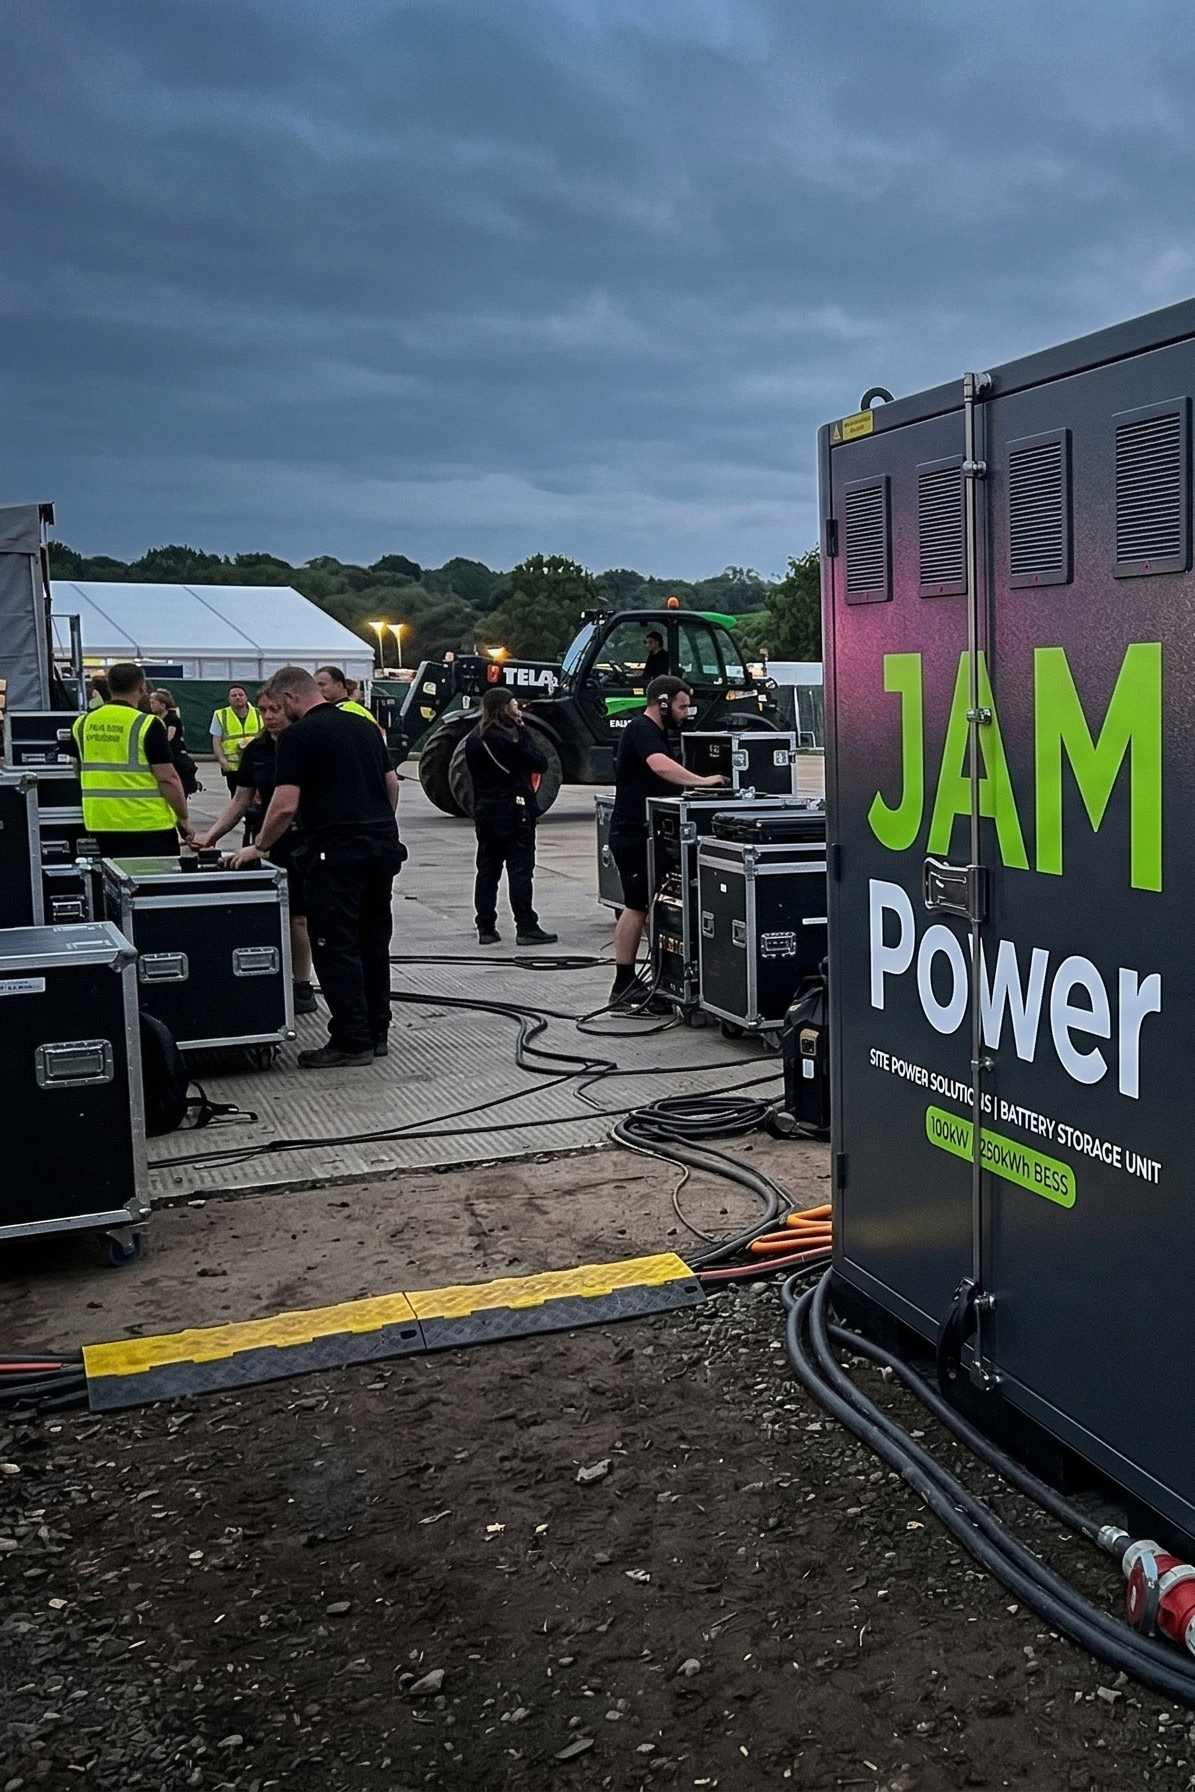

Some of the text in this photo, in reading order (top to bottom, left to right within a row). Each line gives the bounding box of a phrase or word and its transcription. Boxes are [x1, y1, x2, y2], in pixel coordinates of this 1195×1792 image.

[868, 642, 1162, 892] JAM
[869, 879, 1162, 1100] Power
[869, 1048, 890, 1072] SITE
[891, 1056, 929, 1089] POWER
[1000, 1100, 1056, 1140] BATTERY
[1057, 1123, 1122, 1169] STORAGE
[1125, 1150, 1162, 1184] UNIT
[930, 1115, 1069, 1196] 100kW 250kWh BESS
